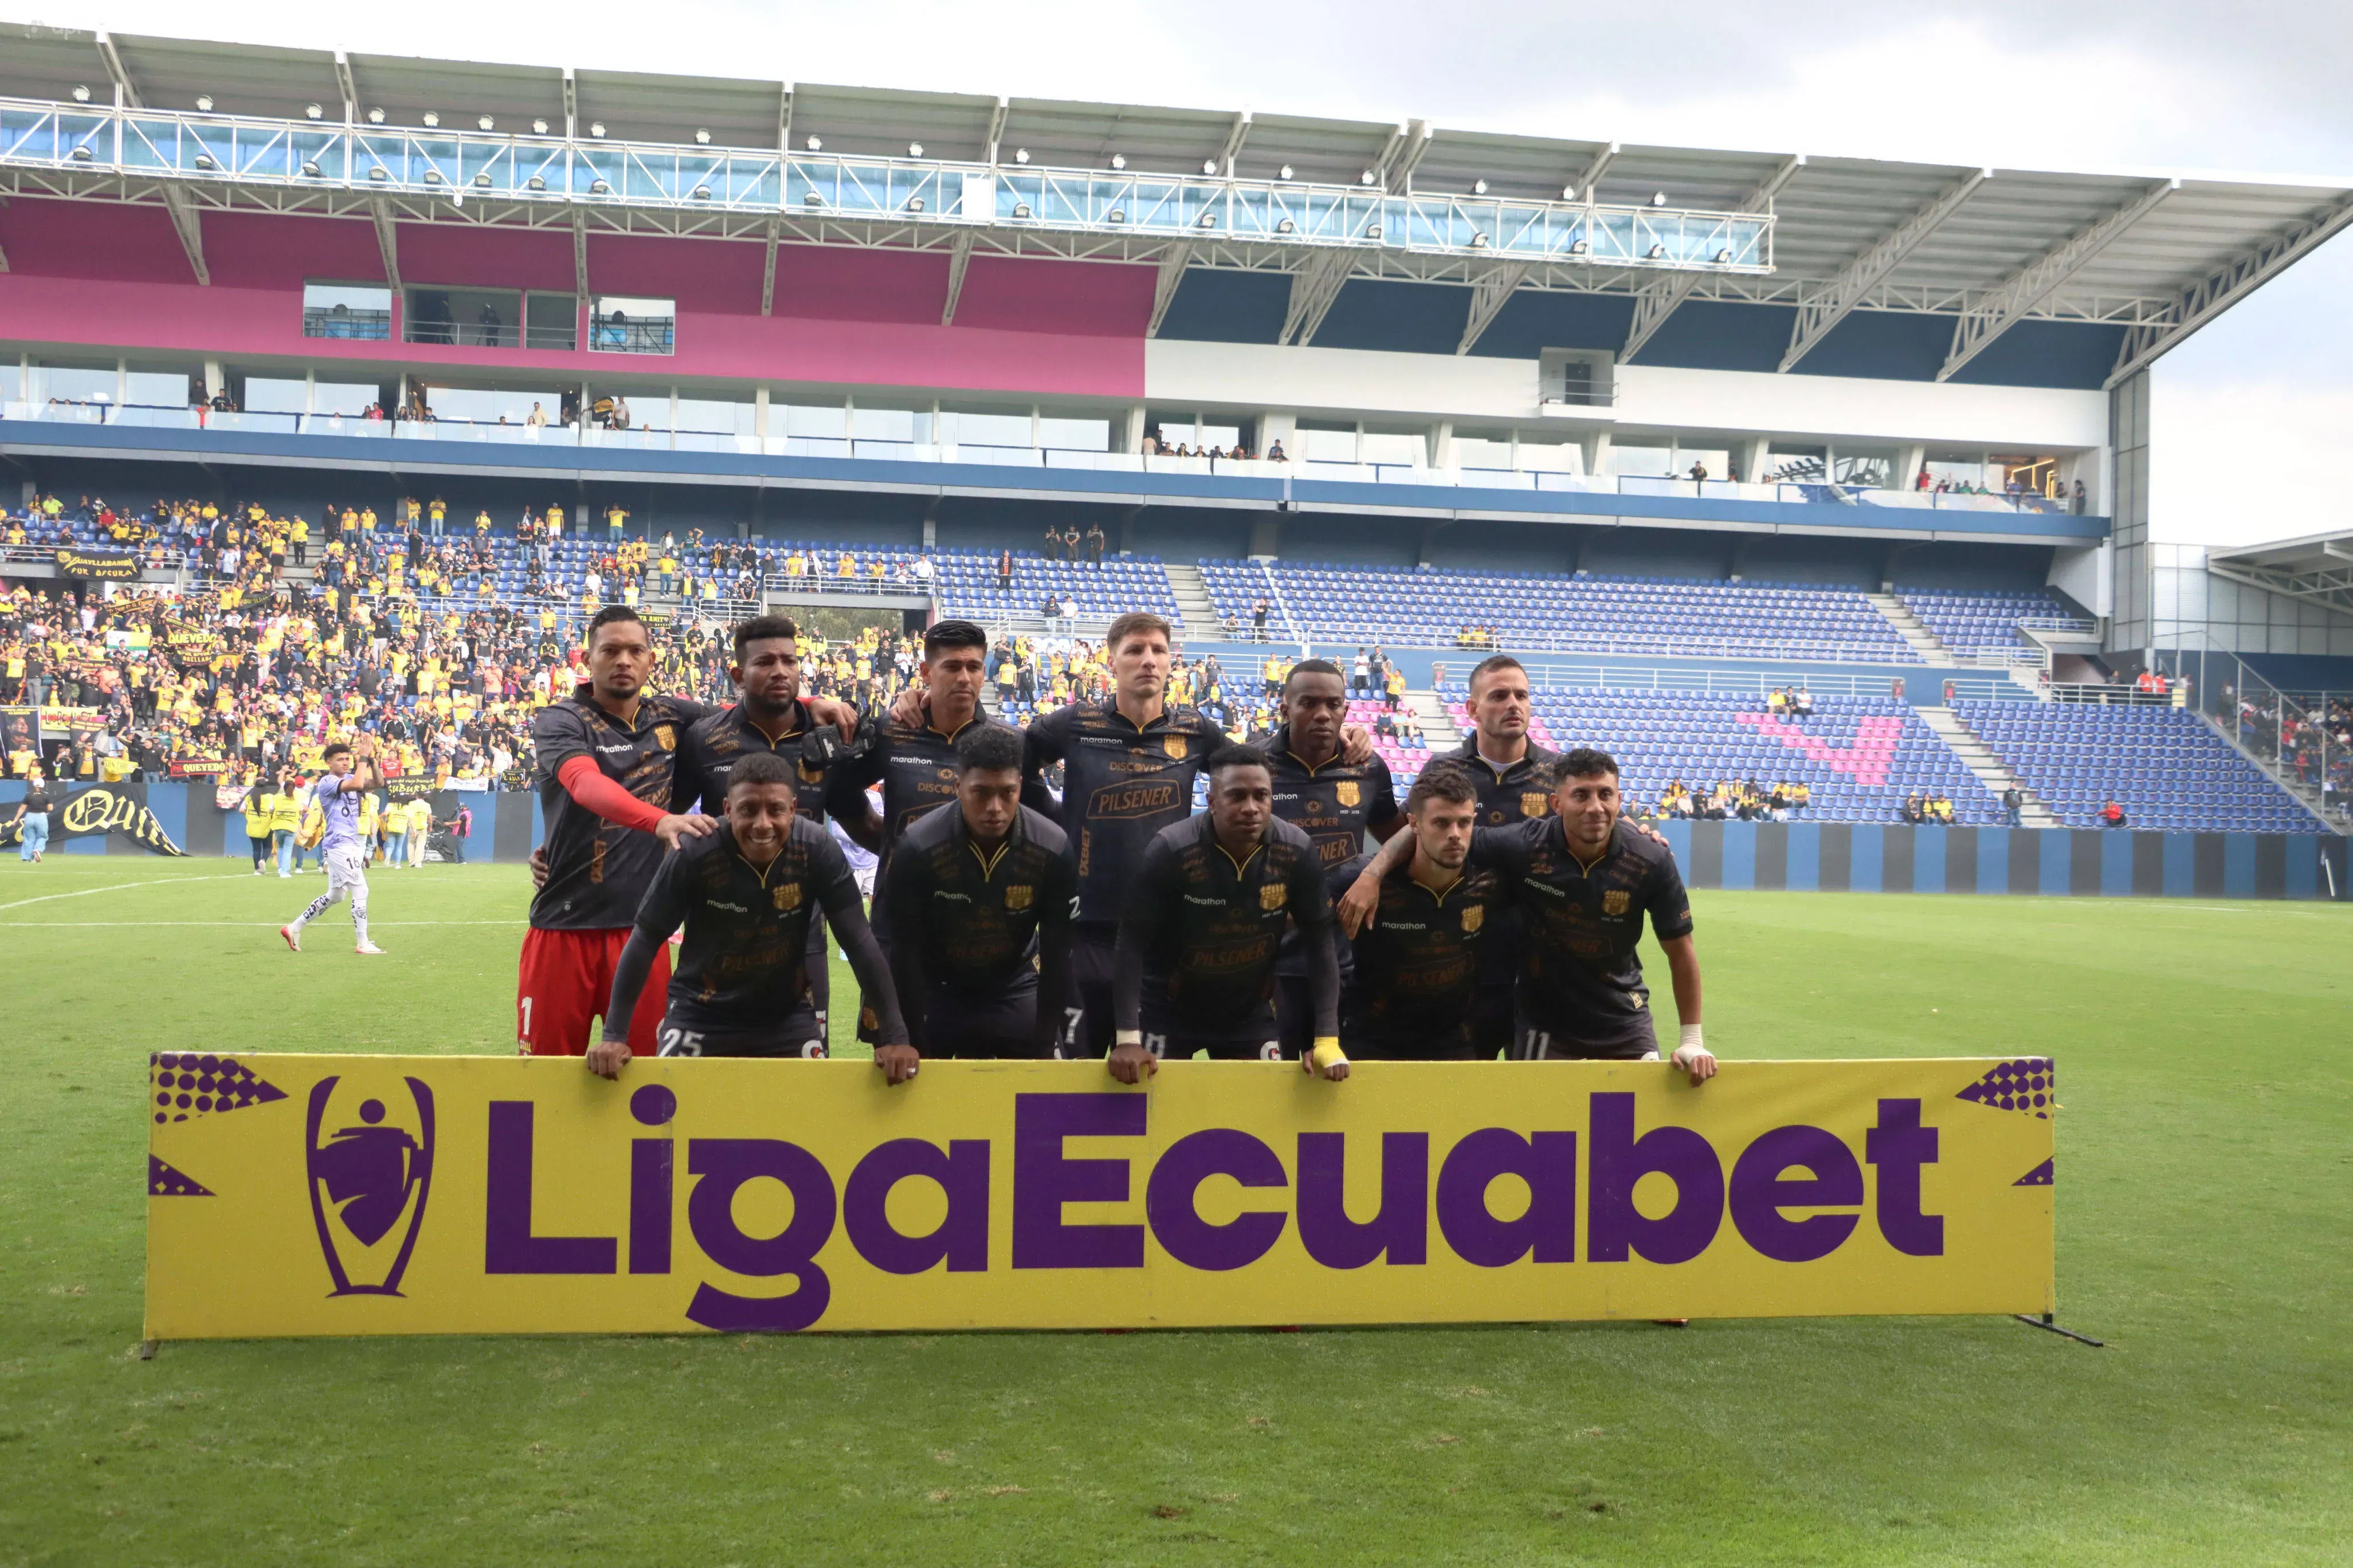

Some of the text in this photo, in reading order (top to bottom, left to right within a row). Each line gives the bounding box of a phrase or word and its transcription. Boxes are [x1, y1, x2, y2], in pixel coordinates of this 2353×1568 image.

[168, 633, 218, 645] QUEVEDO
[891, 756, 932, 765] marathon
[1109, 761, 1163, 773] DISCOVER
[917, 783, 958, 795] DISCOV
[1098, 786, 1172, 814] PILSENER
[1272, 793, 1298, 801] athon
[346, 856, 360, 870] 16
[1524, 877, 1565, 898] marathon
[707, 899, 748, 913] marathon
[1183, 893, 1226, 906] marathon
[1382, 921, 1426, 930] marathon
[520, 996, 533, 1035] 1
[1064, 1007, 1084, 1044] 7
[657, 1028, 705, 1058] 25
[1524, 1029, 1551, 1059] 11
[486, 1084, 1943, 1331] LigaEcuabet
